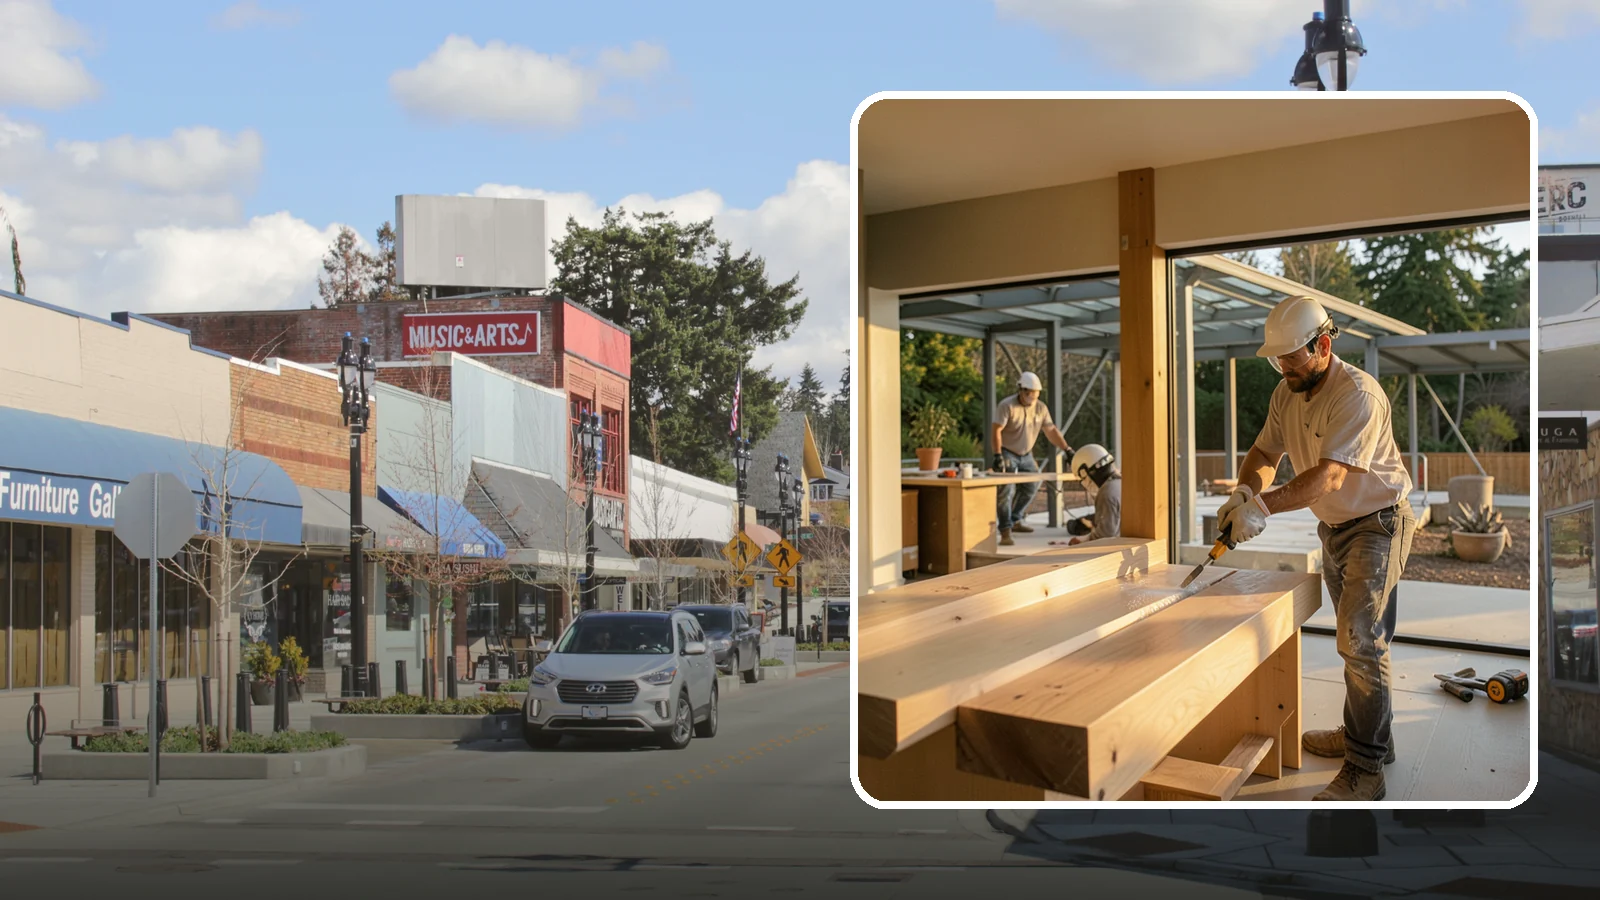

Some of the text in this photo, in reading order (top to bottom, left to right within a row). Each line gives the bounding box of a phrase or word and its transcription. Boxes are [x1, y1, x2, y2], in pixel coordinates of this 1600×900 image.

[409, 323, 519, 348] MUSIC&ARTS
[0, 471, 79, 515] Furniture
[453, 563, 479, 574] SUSHI
